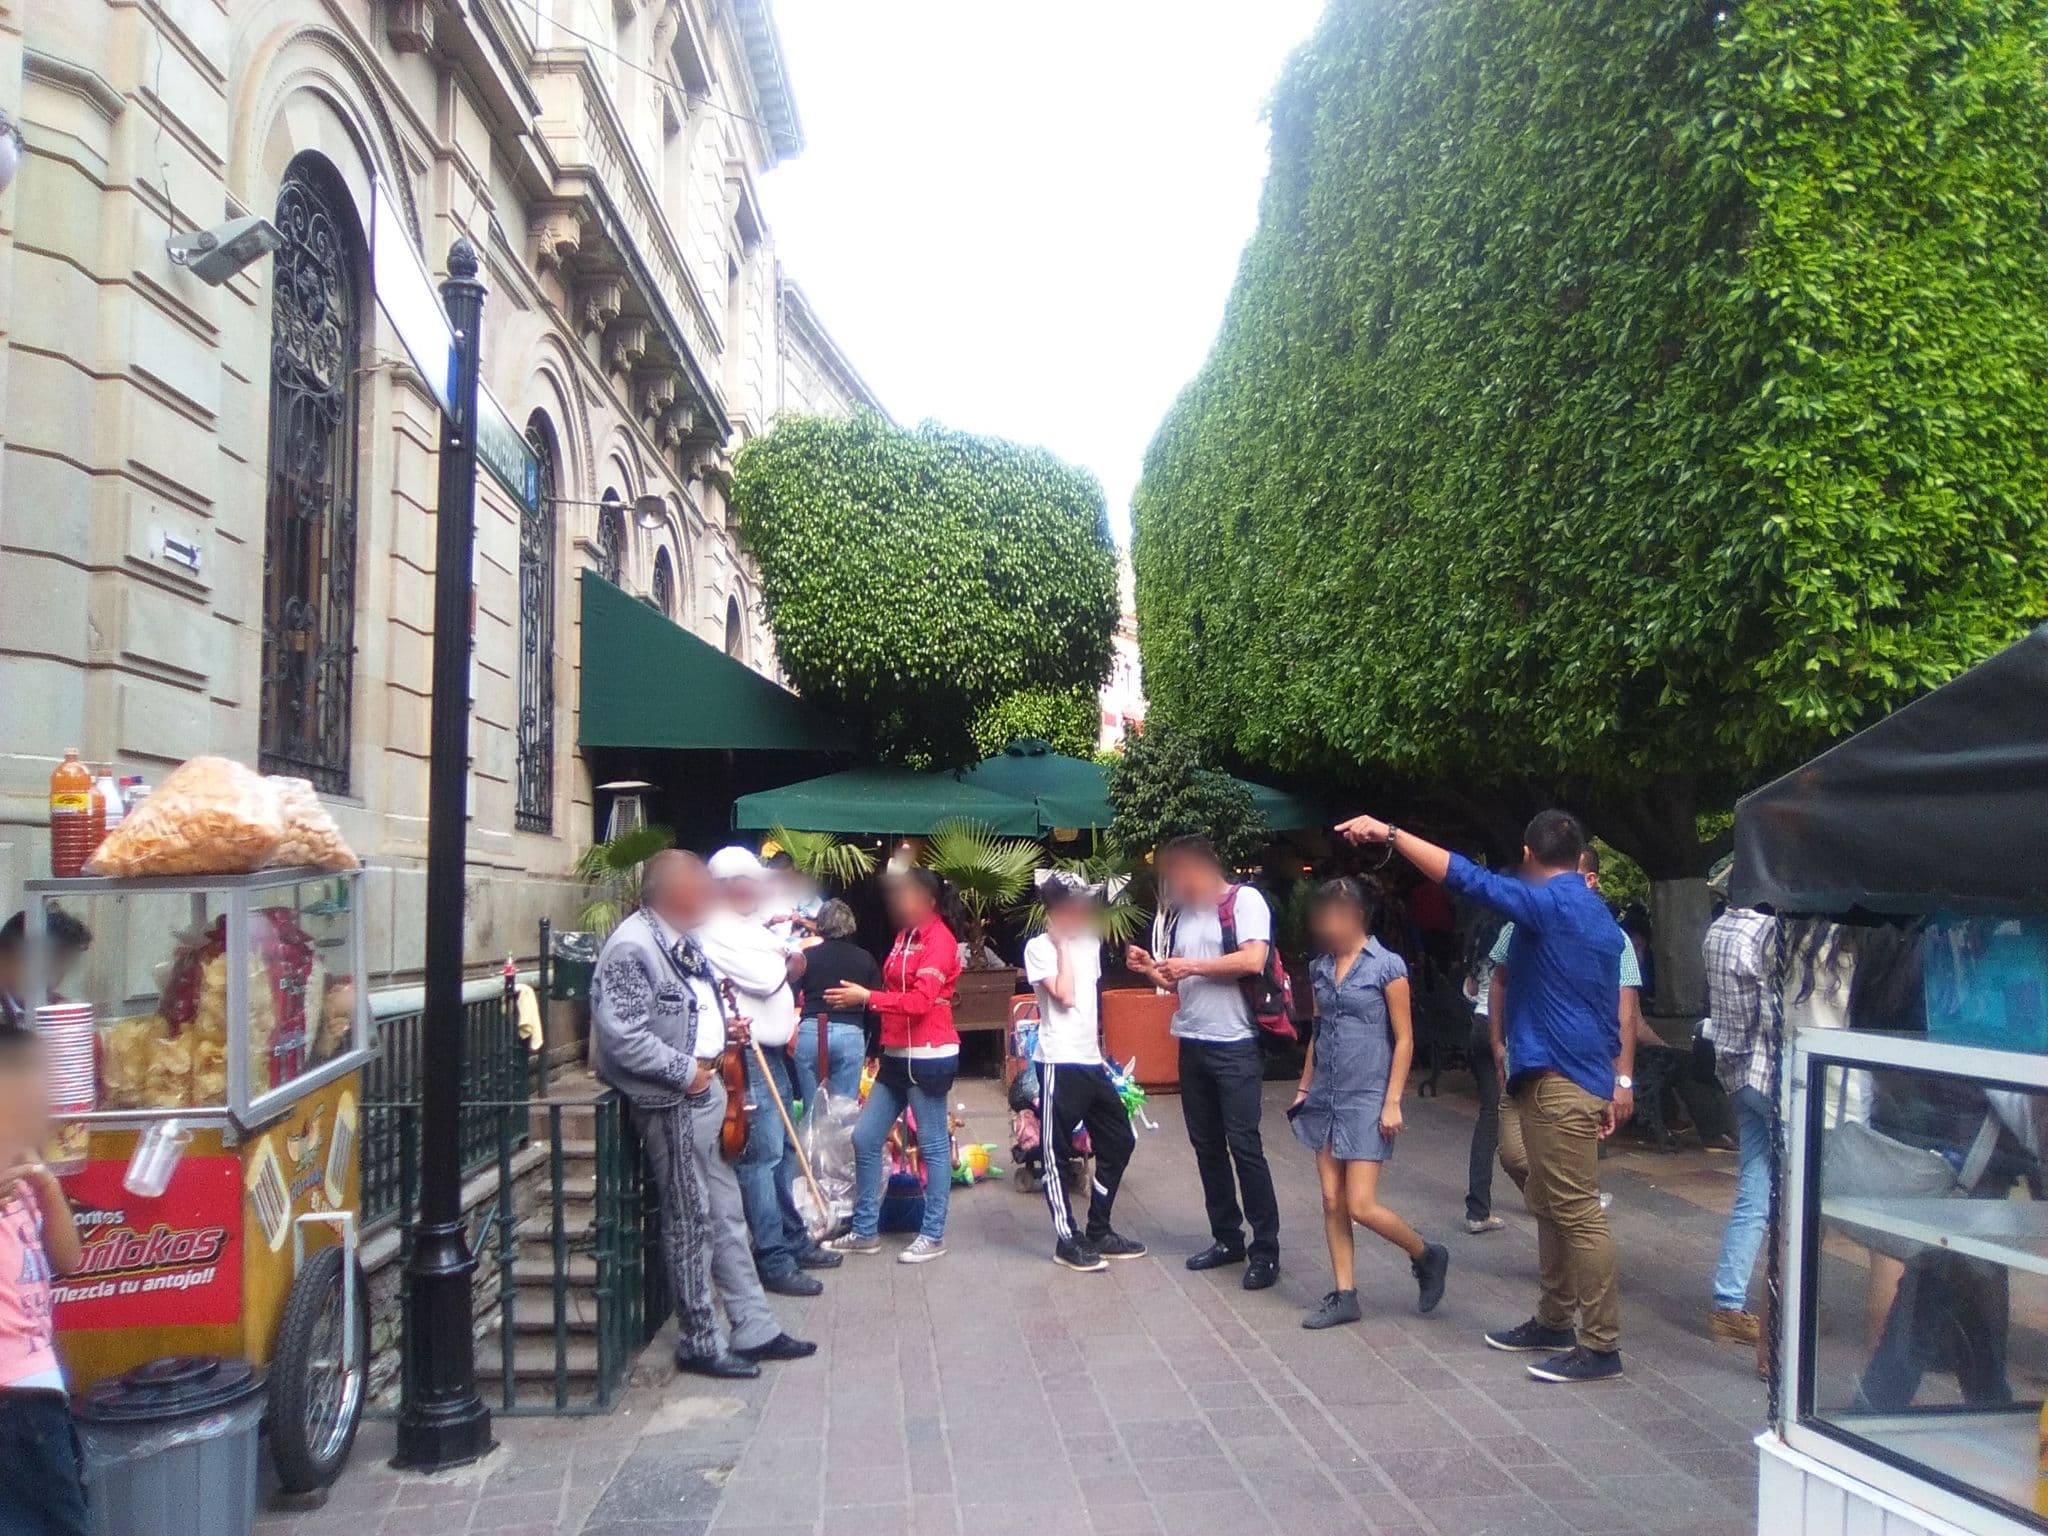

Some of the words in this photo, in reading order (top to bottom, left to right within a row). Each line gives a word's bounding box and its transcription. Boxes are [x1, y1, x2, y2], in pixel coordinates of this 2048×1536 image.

[72, 1209, 125, 1225] oritos
[50, 1282, 115, 1303] Mezcla
[119, 1280, 139, 1295] tu
[143, 1267, 216, 1290] antojo!!
